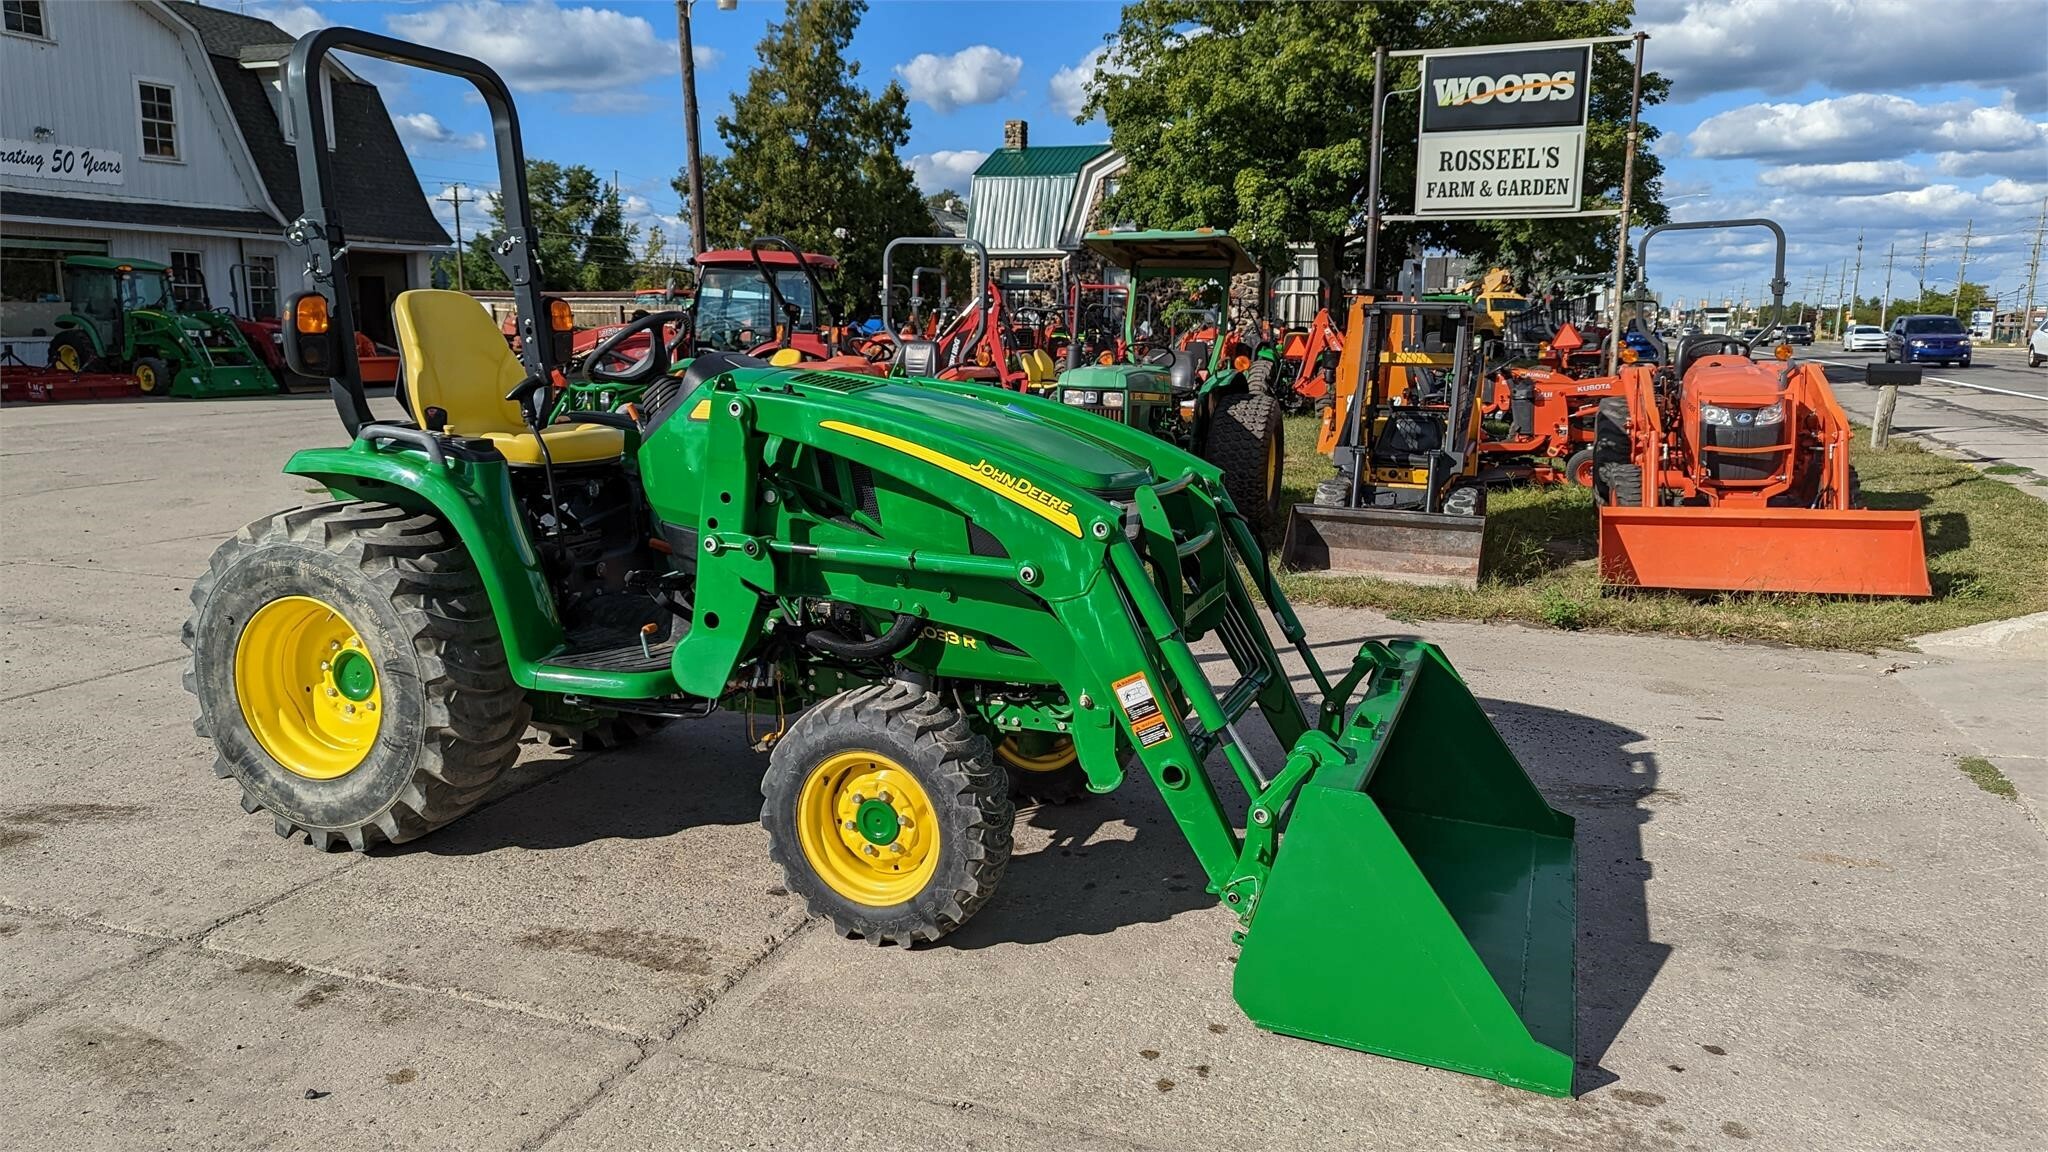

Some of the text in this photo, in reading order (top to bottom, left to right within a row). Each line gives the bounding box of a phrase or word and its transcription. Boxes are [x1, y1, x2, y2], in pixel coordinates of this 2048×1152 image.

[1433, 70, 1576, 107] WOODS
[51, 149, 75, 174] 50
[81, 150, 122, 177] Years
[1438, 146, 1560, 172] ROSSEEL'S
[1426, 178, 1570, 199] FARM & GARDEN
[1576, 383, 1612, 392] KUBOTA
[970, 459, 1073, 515] JOHN DEERE
